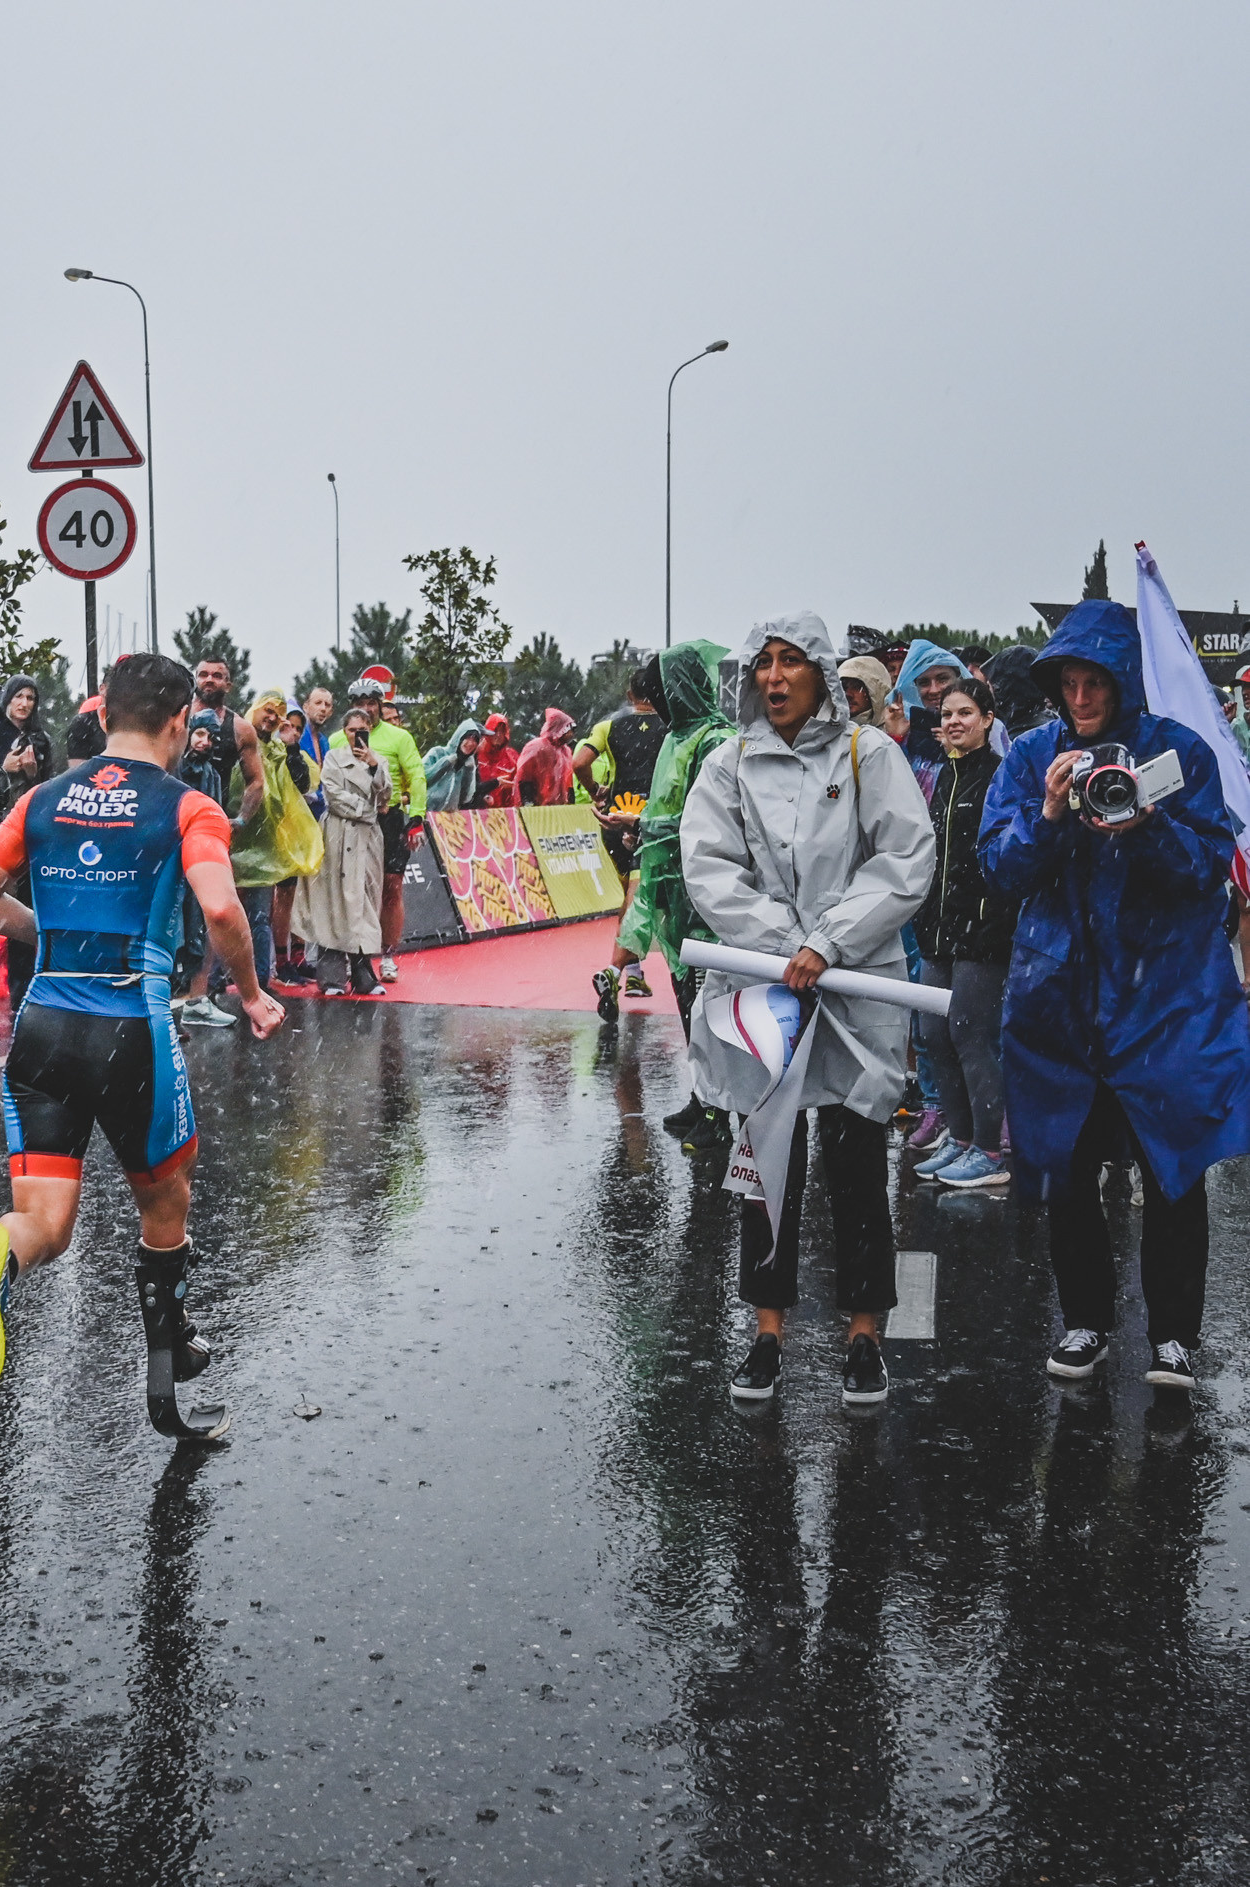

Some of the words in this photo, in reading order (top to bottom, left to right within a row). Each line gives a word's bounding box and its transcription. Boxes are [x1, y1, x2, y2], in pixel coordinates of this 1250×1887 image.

[58, 510, 115, 549] 40
[67, 782, 138, 803] ИНТЕР
[538, 832, 598, 855] FAHRENHEIT
[40, 866, 138, 882] ОРТО-СПОРТ
